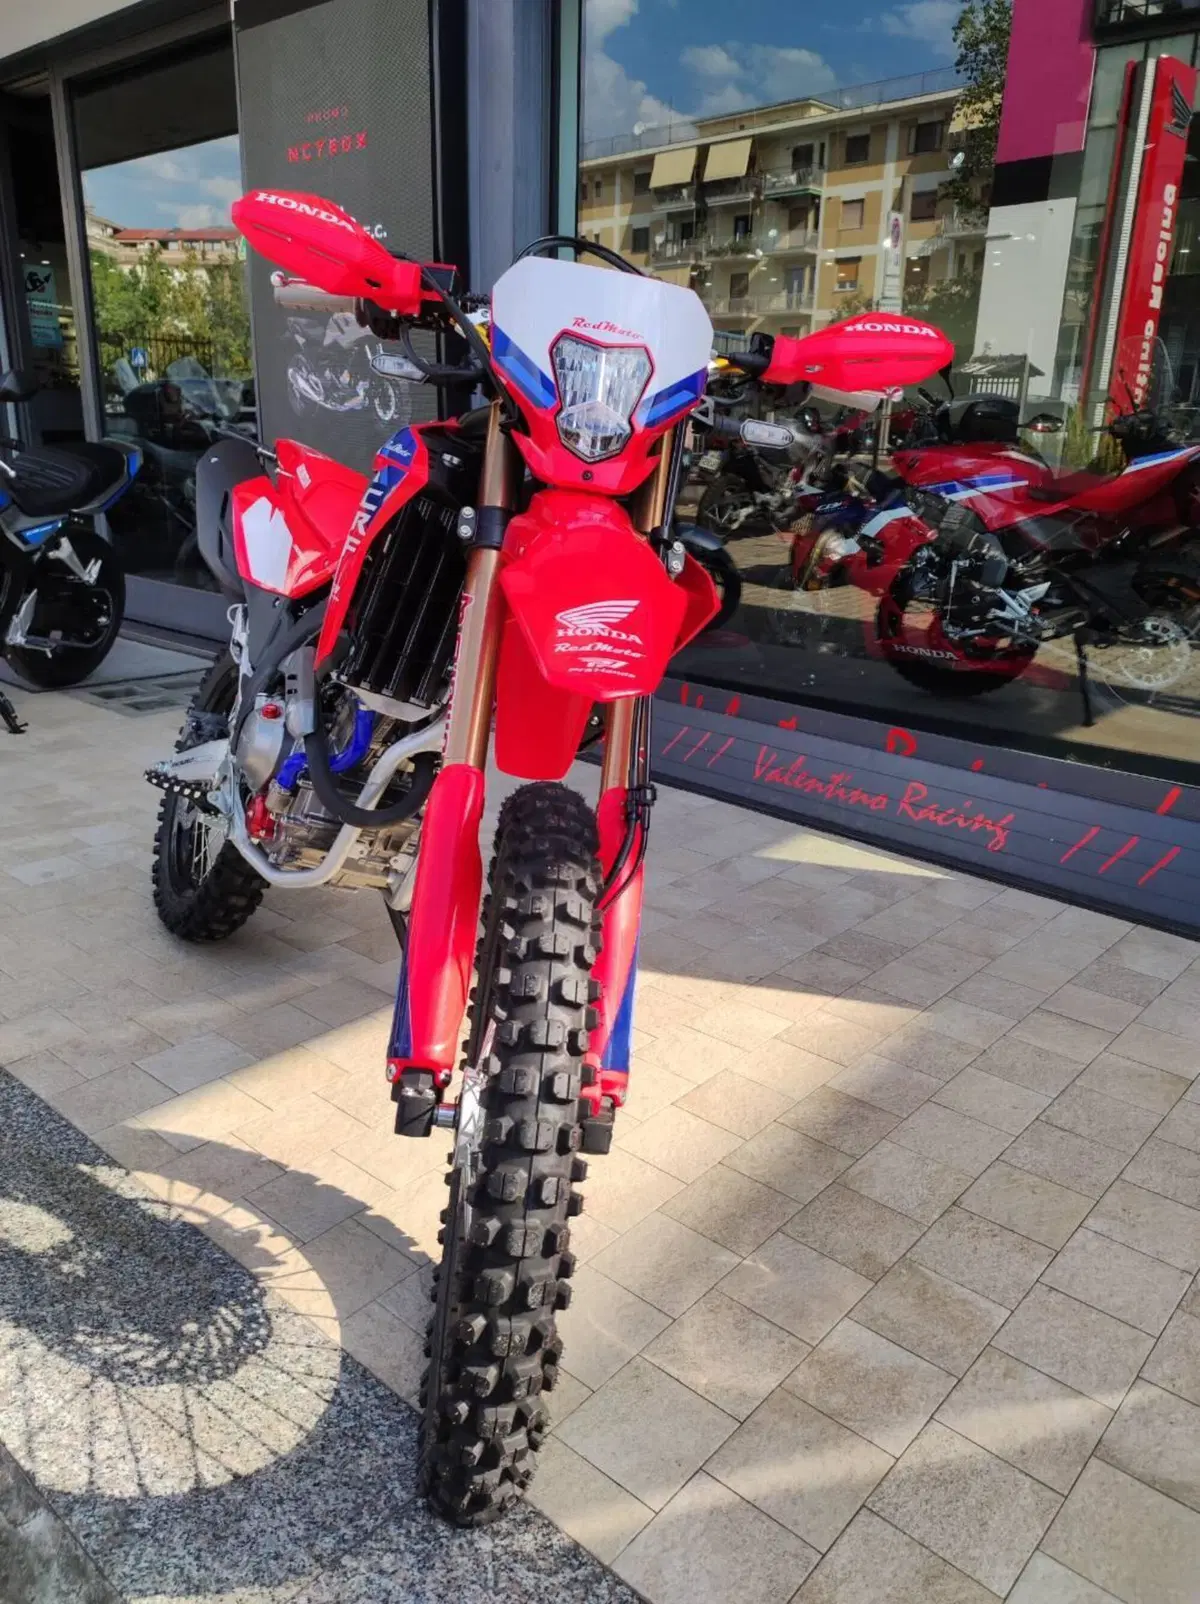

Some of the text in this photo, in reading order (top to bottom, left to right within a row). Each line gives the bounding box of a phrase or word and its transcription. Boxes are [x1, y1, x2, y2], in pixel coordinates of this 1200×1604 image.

[255, 191, 357, 234] HONDA
[843, 322, 939, 339] HONDA
[555, 627, 644, 646] HONDA
[892, 643, 960, 660] HONDA
[752, 744, 1016, 853] Valentino Racing
